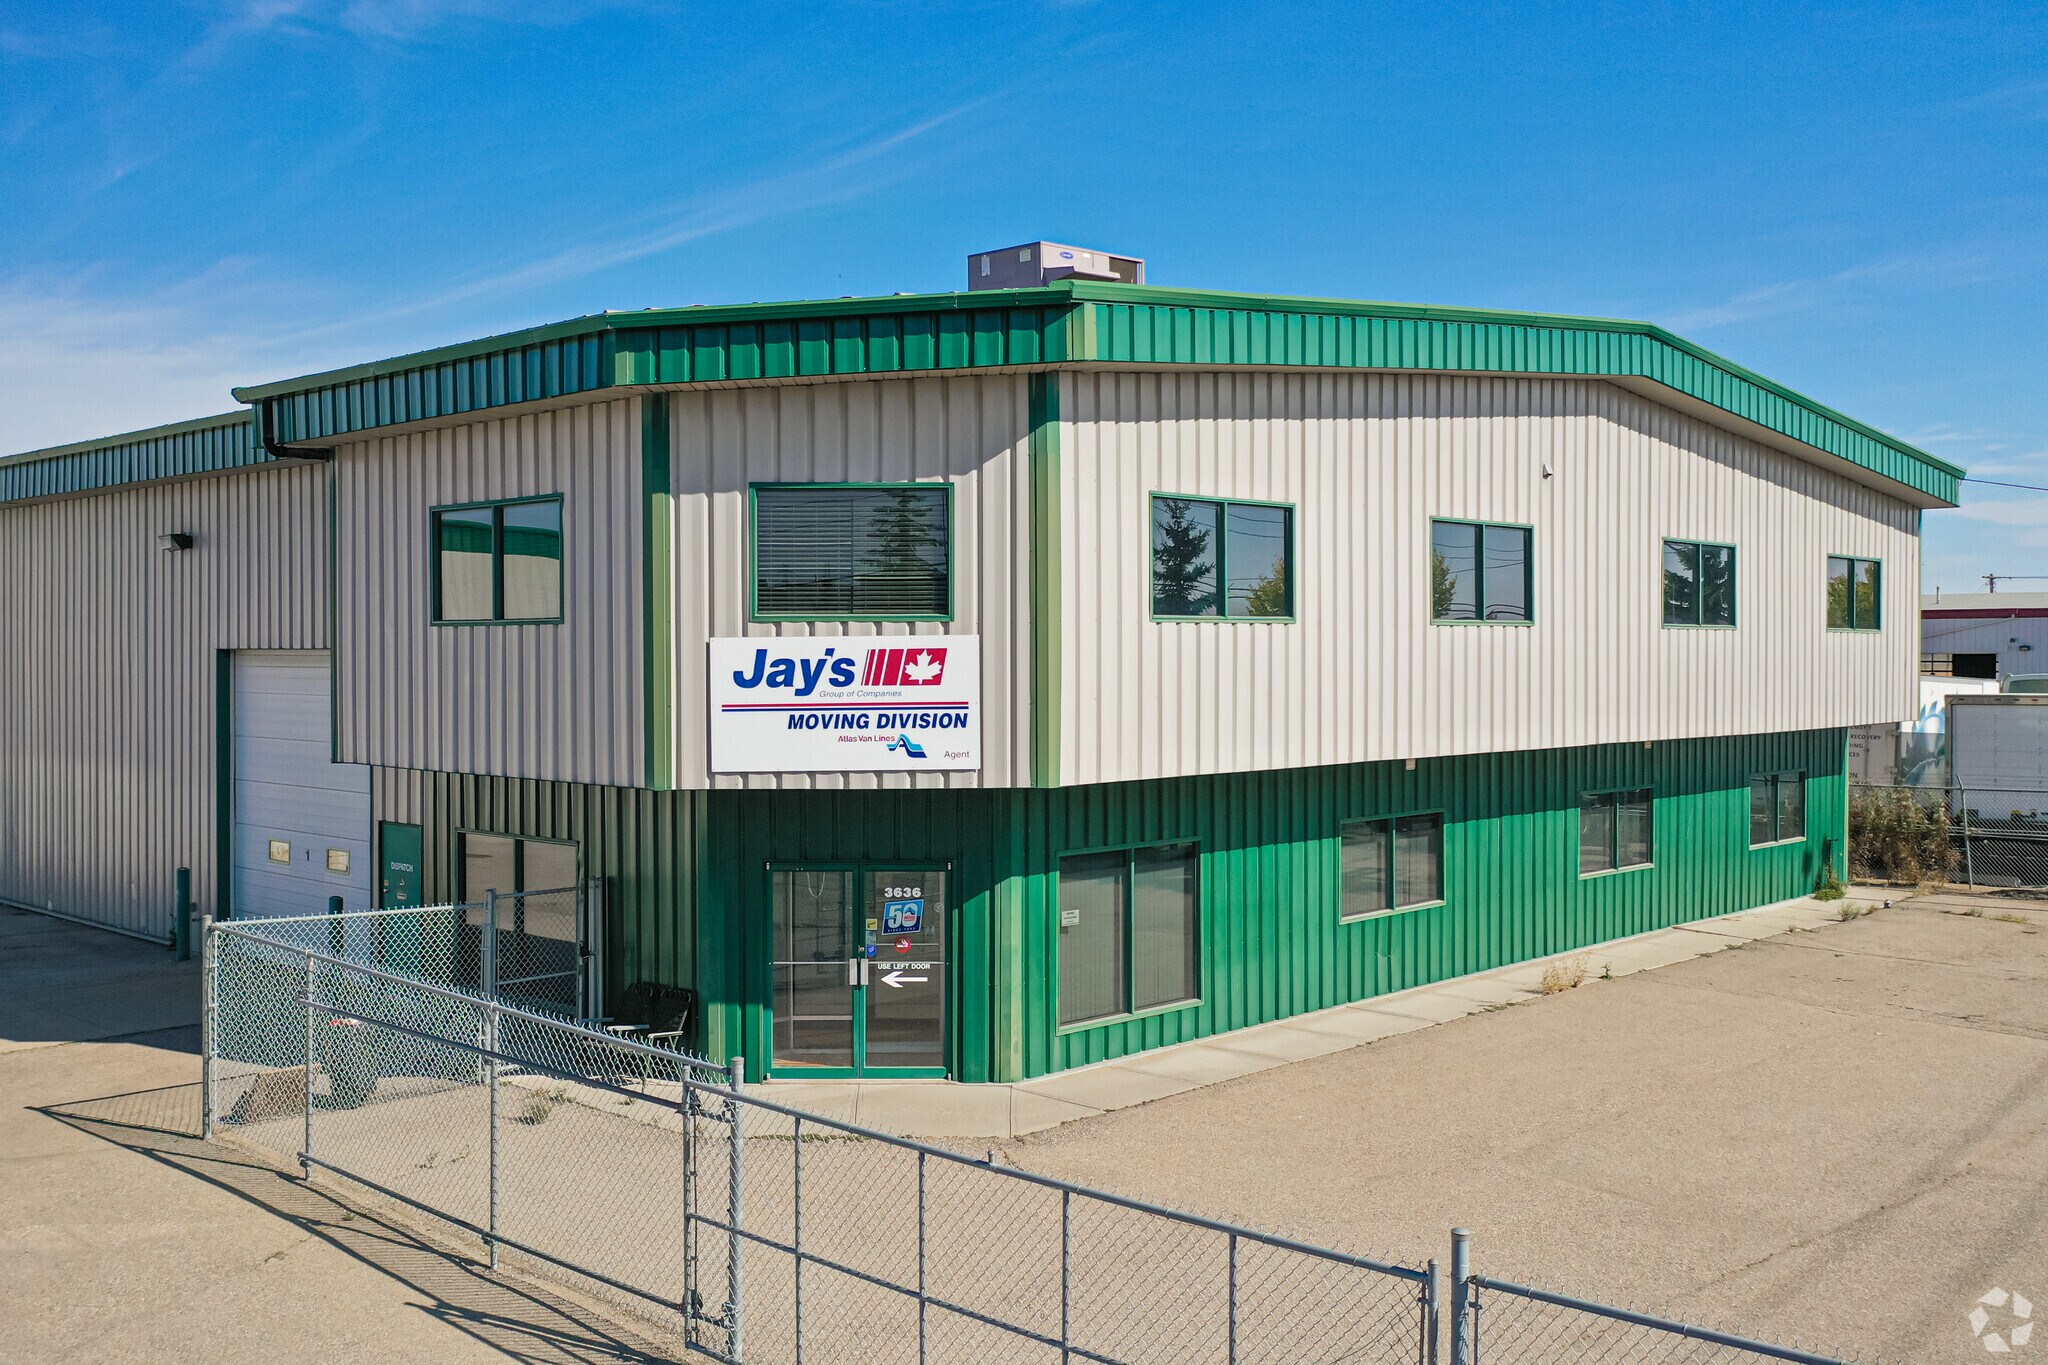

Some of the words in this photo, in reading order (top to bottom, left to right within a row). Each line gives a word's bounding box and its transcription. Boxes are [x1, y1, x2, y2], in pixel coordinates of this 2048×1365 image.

[733, 648, 856, 696] Jay's
[819, 690, 844, 698] Group
[856, 690, 902, 698] Companies
[788, 713, 869, 730] MOVING
[876, 713, 968, 729] DIVISION
[838, 735, 858, 743] Atlas
[944, 750, 970, 759] Agent
[305, 848, 310, 861] 1
[391, 862, 413, 872] DISPATCH
[884, 887, 922, 898] 3636
[888, 903, 918, 928] 50
